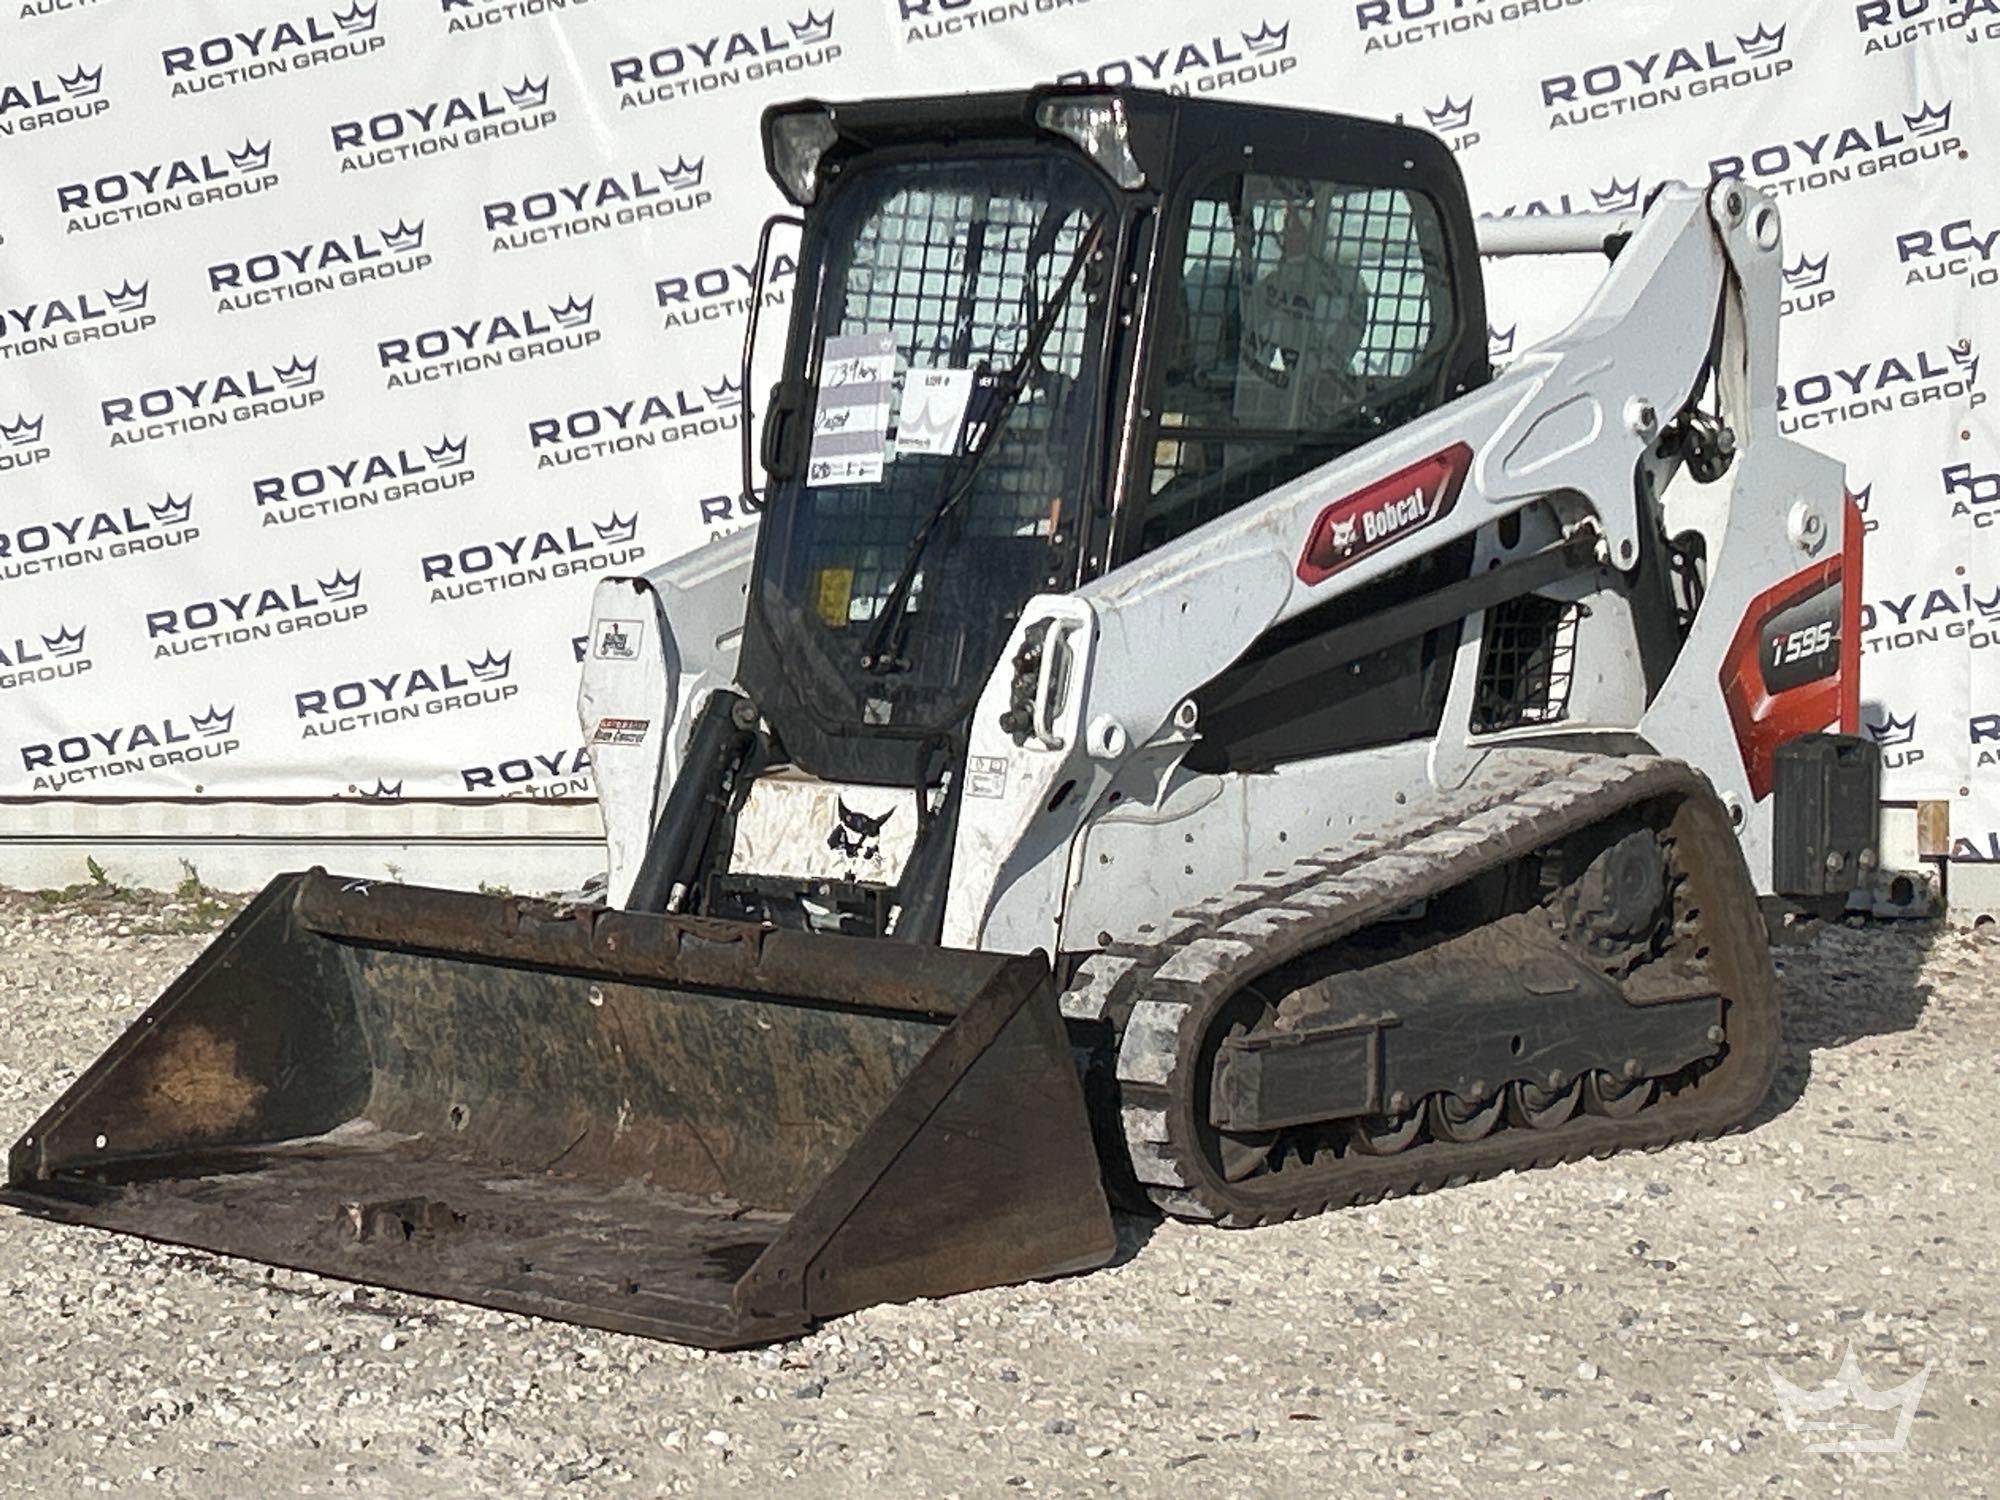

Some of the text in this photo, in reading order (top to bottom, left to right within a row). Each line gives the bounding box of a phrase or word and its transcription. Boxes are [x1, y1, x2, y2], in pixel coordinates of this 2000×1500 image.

[162, 17, 335, 76] ROYAL
[907, 1, 1029, 43] AUCTION
[1365, 10, 1493, 54] AUCTION
[172, 36, 385, 98] AUCTION GROUP
[610, 26, 789, 88] ROYAL
[621, 45, 841, 110] AUCTION GROUP
[1198, 57, 1296, 92] GROUP
[1541, 40, 1736, 107] ROYAL
[19, 100, 109, 131] GROUP
[331, 92, 505, 152] ROYAL
[1550, 59, 1793, 130] AUCTION GROUP
[341, 110, 556, 173] AUCTION GROUP
[1758, 137, 1960, 199] CTION GROUP
[57, 155, 229, 213] ROYAL
[67, 174, 278, 234] AUCTION GROUP
[483, 171, 660, 231] ROYAL
[493, 192, 712, 252] AUCTION GROUP
[208, 234, 382, 292] ROYAL
[218, 254, 432, 313] AUCTION GROUP
[655, 253, 798, 307] ROYA
[0, 294, 106, 338] YAL
[63, 315, 156, 345] GROUP
[1779, 289, 1836, 317] OUP
[377, 310, 550, 368] ROYAL
[387, 330, 601, 389] AUCTION GROUP
[101, 370, 275, 426] ROYAL
[111, 390, 324, 447] AUCTION GROUP
[529, 390, 704, 448] ROYAL
[1780, 396, 1893, 434] UCTION
[0, 448, 50, 471] OUP
[253, 450, 426, 506] ROYAL
[538, 432, 655, 469] AUCTION
[263, 470, 474, 527] AUCTION GROUP
[1363, 488, 1425, 543] Bobcat
[0, 528, 199, 580] UCTION GROUP
[421, 526, 594, 582] ROYAL
[431, 547, 645, 603] AUCTION GROUP
[146, 584, 318, 638] ROYAL
[155, 604, 368, 659] AUCTION GROUP
[1772, 621, 1832, 667] T595
[1866, 627, 1938, 654] TION
[0, 660, 92, 689] GROUP
[295, 664, 468, 719] ROYAL
[302, 685, 518, 739] AUCTION GROUP
[20, 720, 190, 771] ROYAL
[34, 740, 239, 791] AUCTION GROUP
[461, 748, 592, 791] ROYA
